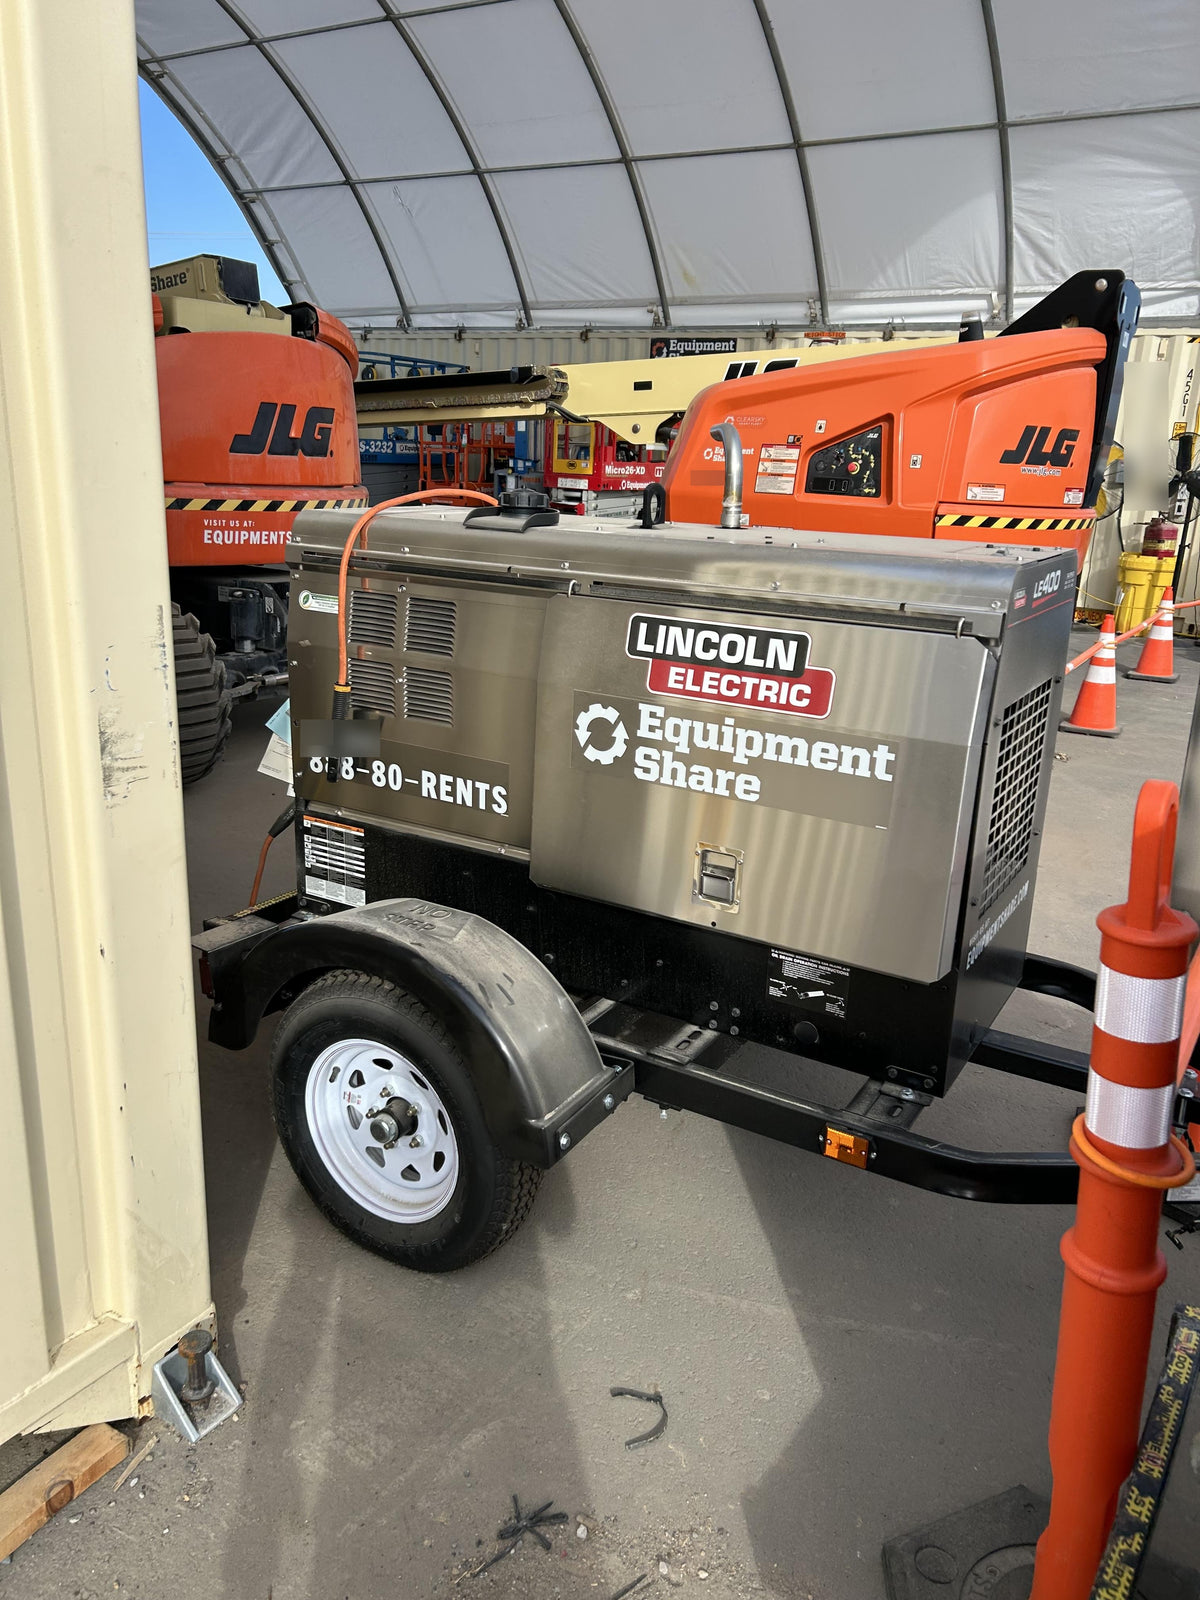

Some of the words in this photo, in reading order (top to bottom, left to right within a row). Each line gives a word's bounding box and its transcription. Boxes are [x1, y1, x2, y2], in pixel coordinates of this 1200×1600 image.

[670, 339, 734, 352] Equipment
[230, 402, 334, 458] JLG
[999, 426, 1080, 468] JLG
[605, 465, 646, 475] Micro26-XD
[1020, 466, 1061, 477] www.jlg.com
[204, 519, 227, 527] VISIT
[230, 519, 241, 527] US
[1033, 569, 1061, 598] LE400
[636, 622, 798, 671] LINCOLN
[668, 666, 812, 707] ELECTRIC
[636, 702, 896, 782] Equipment
[310, 756, 508, 815] 88-80-RENTS
[634, 746, 760, 802] Share
[384, 912, 437, 932] STEP
[409, 902, 452, 919] NO
[794, 958, 818, 968] OPERATION
[818, 965, 849, 976] INSTRUCTIONS
